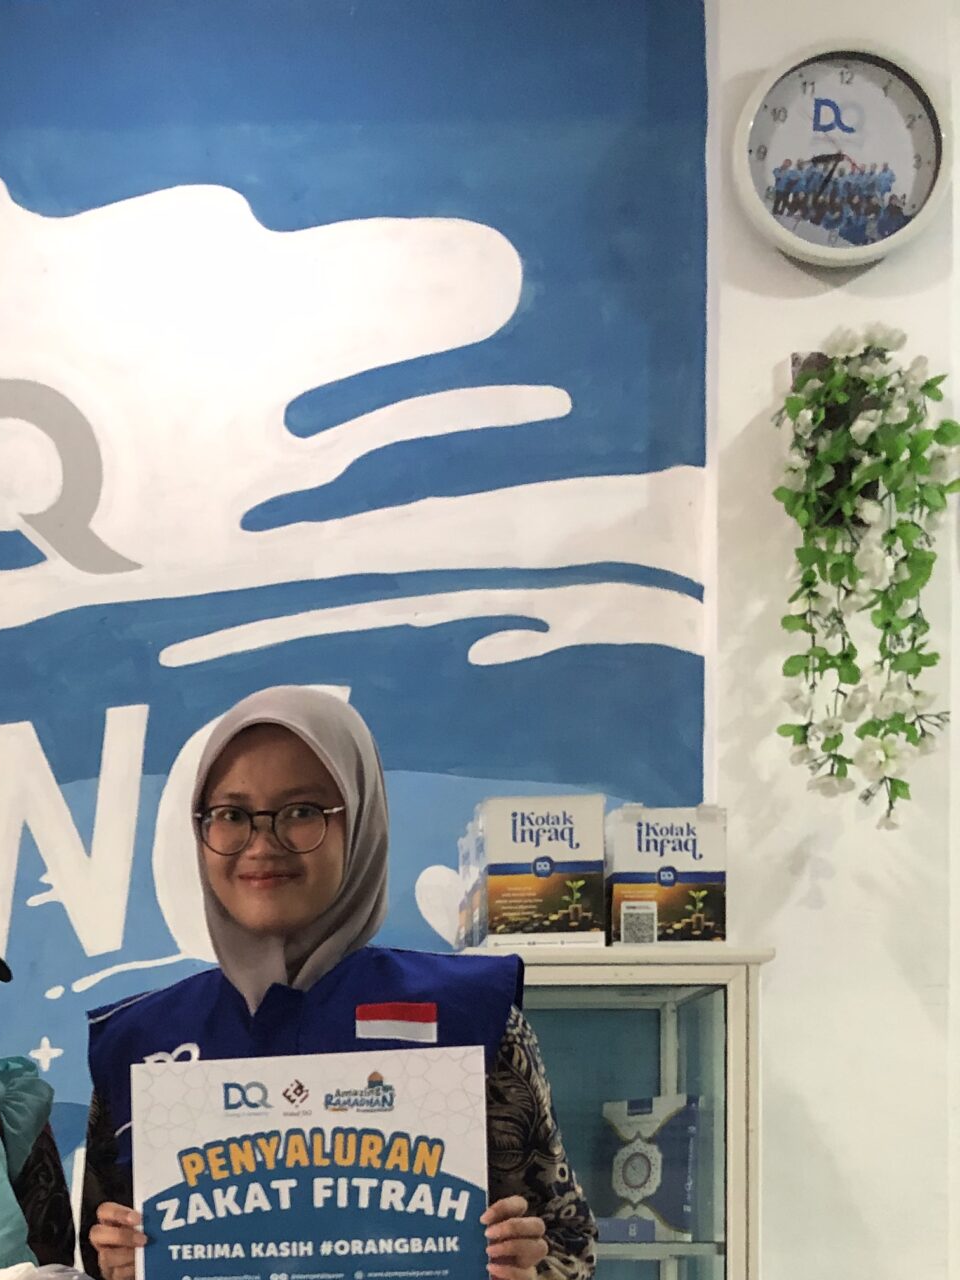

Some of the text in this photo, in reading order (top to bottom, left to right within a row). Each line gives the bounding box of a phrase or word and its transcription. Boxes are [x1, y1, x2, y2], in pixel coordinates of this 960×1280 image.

[839, 70, 855, 85] 12
[801, 80, 816, 95] 11
[883, 84, 890, 98] 1
[771, 106, 788, 123] 10
[905, 114, 917, 130] 2
[756, 144, 768, 161] 9
[913, 153, 923, 170] 3
[520, 810, 574, 826] Kotak
[645, 821, 697, 836] Kotak
[222, 1081, 274, 1110] DQ
[178, 1128, 444, 1187] PENYALURAN
[155, 1177, 470, 1231] ZAKAT FITRAH
[168, 1236, 460, 1260] TERIMA KASIH #ORANGBAIK
